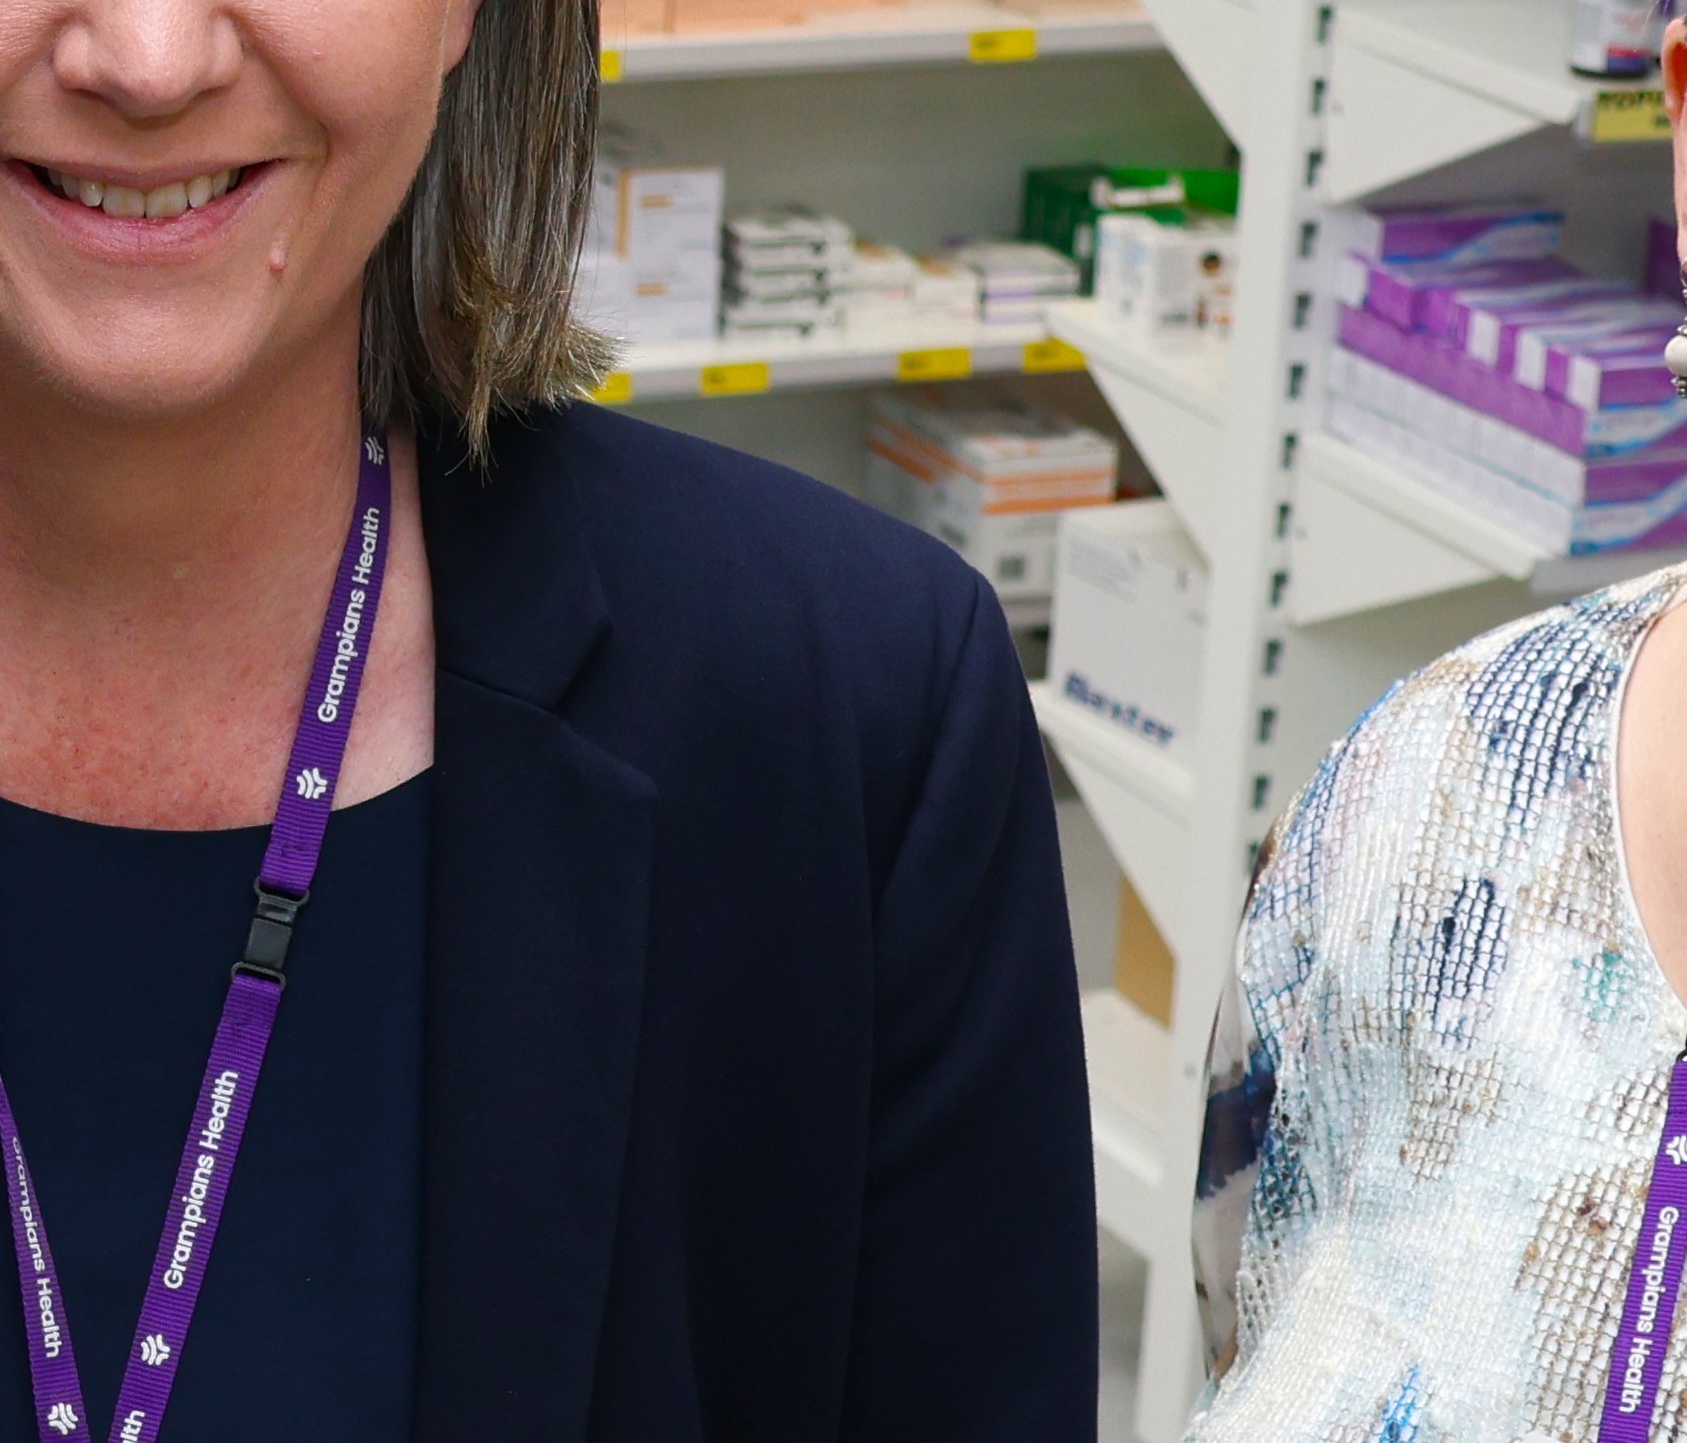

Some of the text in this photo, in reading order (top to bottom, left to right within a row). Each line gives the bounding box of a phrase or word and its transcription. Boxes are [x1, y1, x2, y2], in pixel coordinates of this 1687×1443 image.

[317, 507, 380, 723] Grampians Health
[12, 1136, 63, 1359] Grampians Health
[163, 1070, 239, 1290] Grampians Health
[1618, 1205, 1680, 1414] Grampians Health
